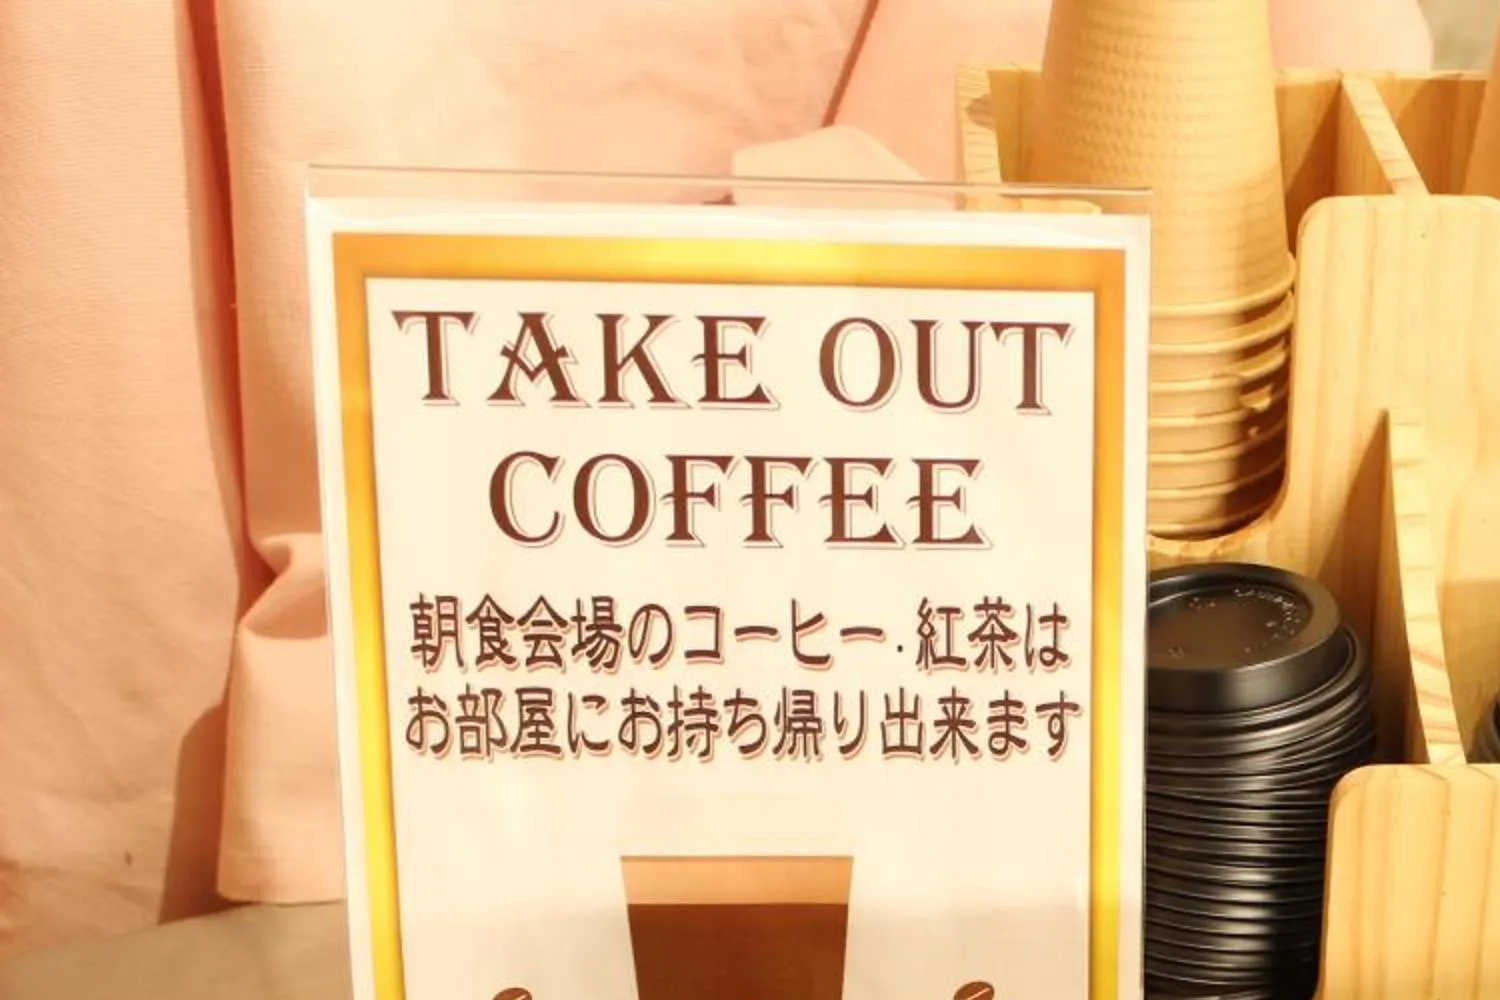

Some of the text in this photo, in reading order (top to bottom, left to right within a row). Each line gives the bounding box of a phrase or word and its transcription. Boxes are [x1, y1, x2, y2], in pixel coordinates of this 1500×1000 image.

[391, 309, 1071, 414] TAKE OUT
[488, 450, 993, 549] COFFEE
[404, 684, 1082, 763] お部屋にお持ち帰り出来ます
